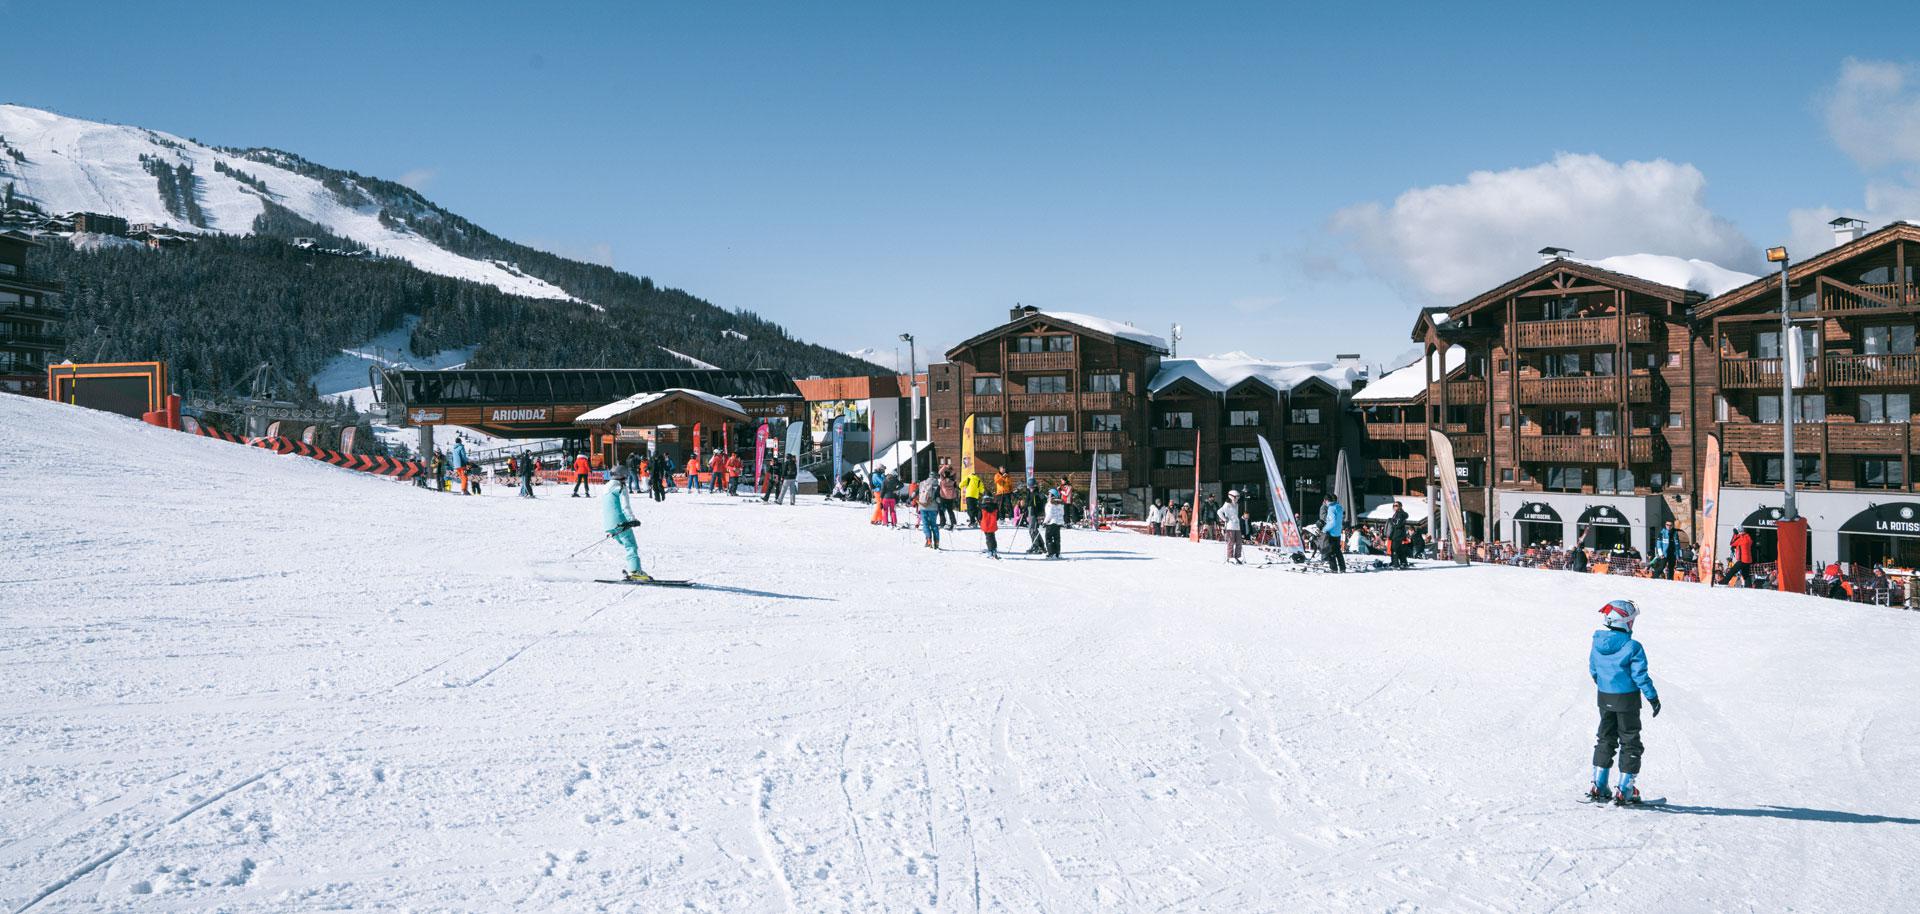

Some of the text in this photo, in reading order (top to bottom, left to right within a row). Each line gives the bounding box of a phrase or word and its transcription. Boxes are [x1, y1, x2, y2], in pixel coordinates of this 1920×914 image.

[492, 409, 546, 420] ARIONDAZ
[1876, 521, 1920, 532] LA ROTISS
